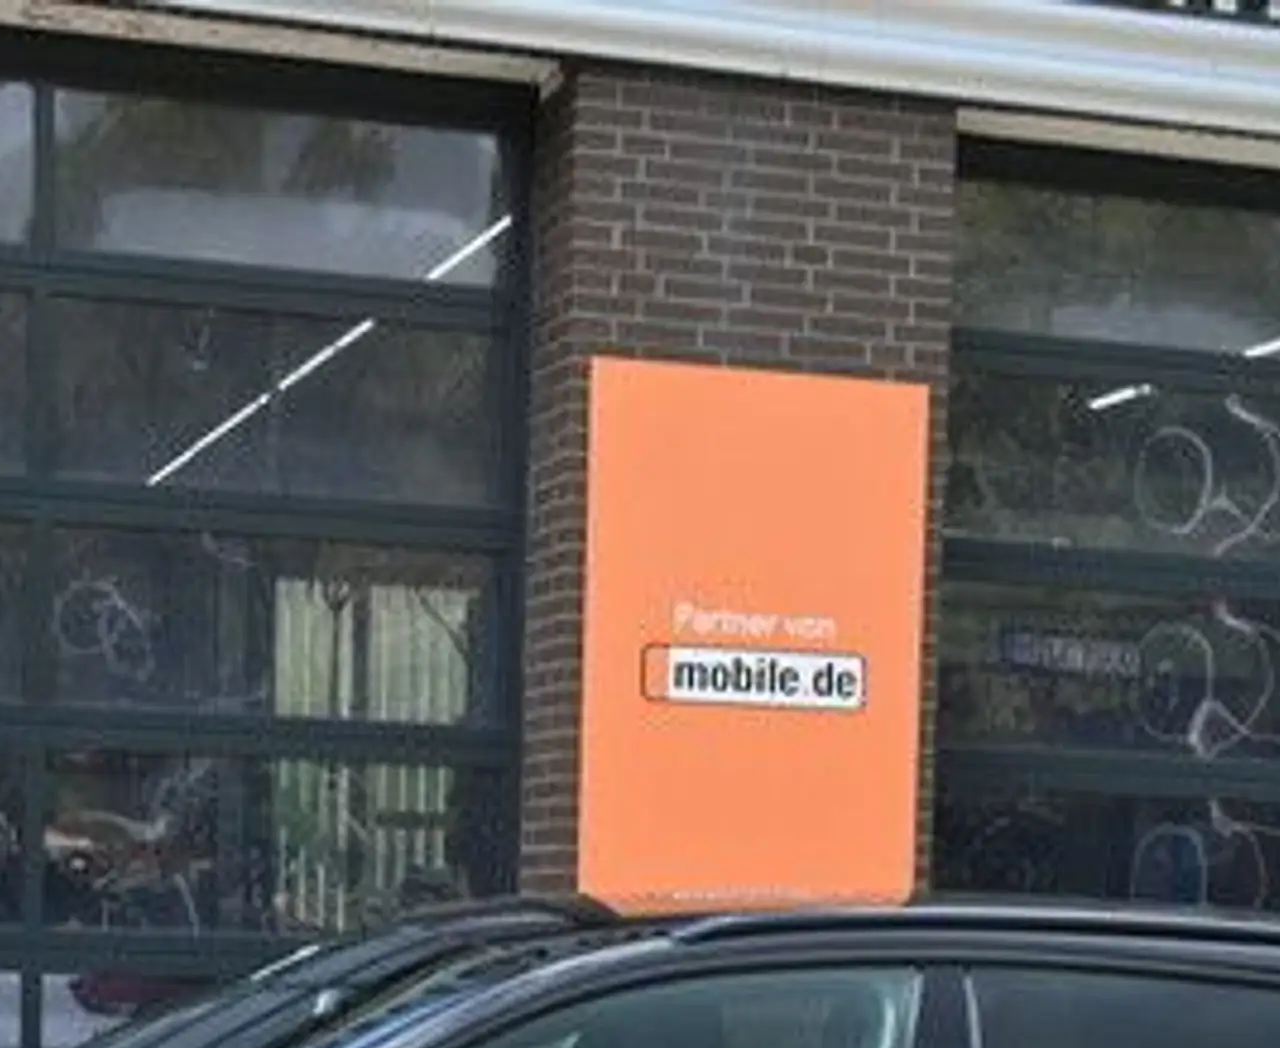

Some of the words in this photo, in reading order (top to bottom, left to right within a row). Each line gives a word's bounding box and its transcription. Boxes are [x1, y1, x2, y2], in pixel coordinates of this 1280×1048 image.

[673, 600, 778, 638] Partner
[782, 615, 836, 638] von
[673, 655, 858, 699] mobile.de
